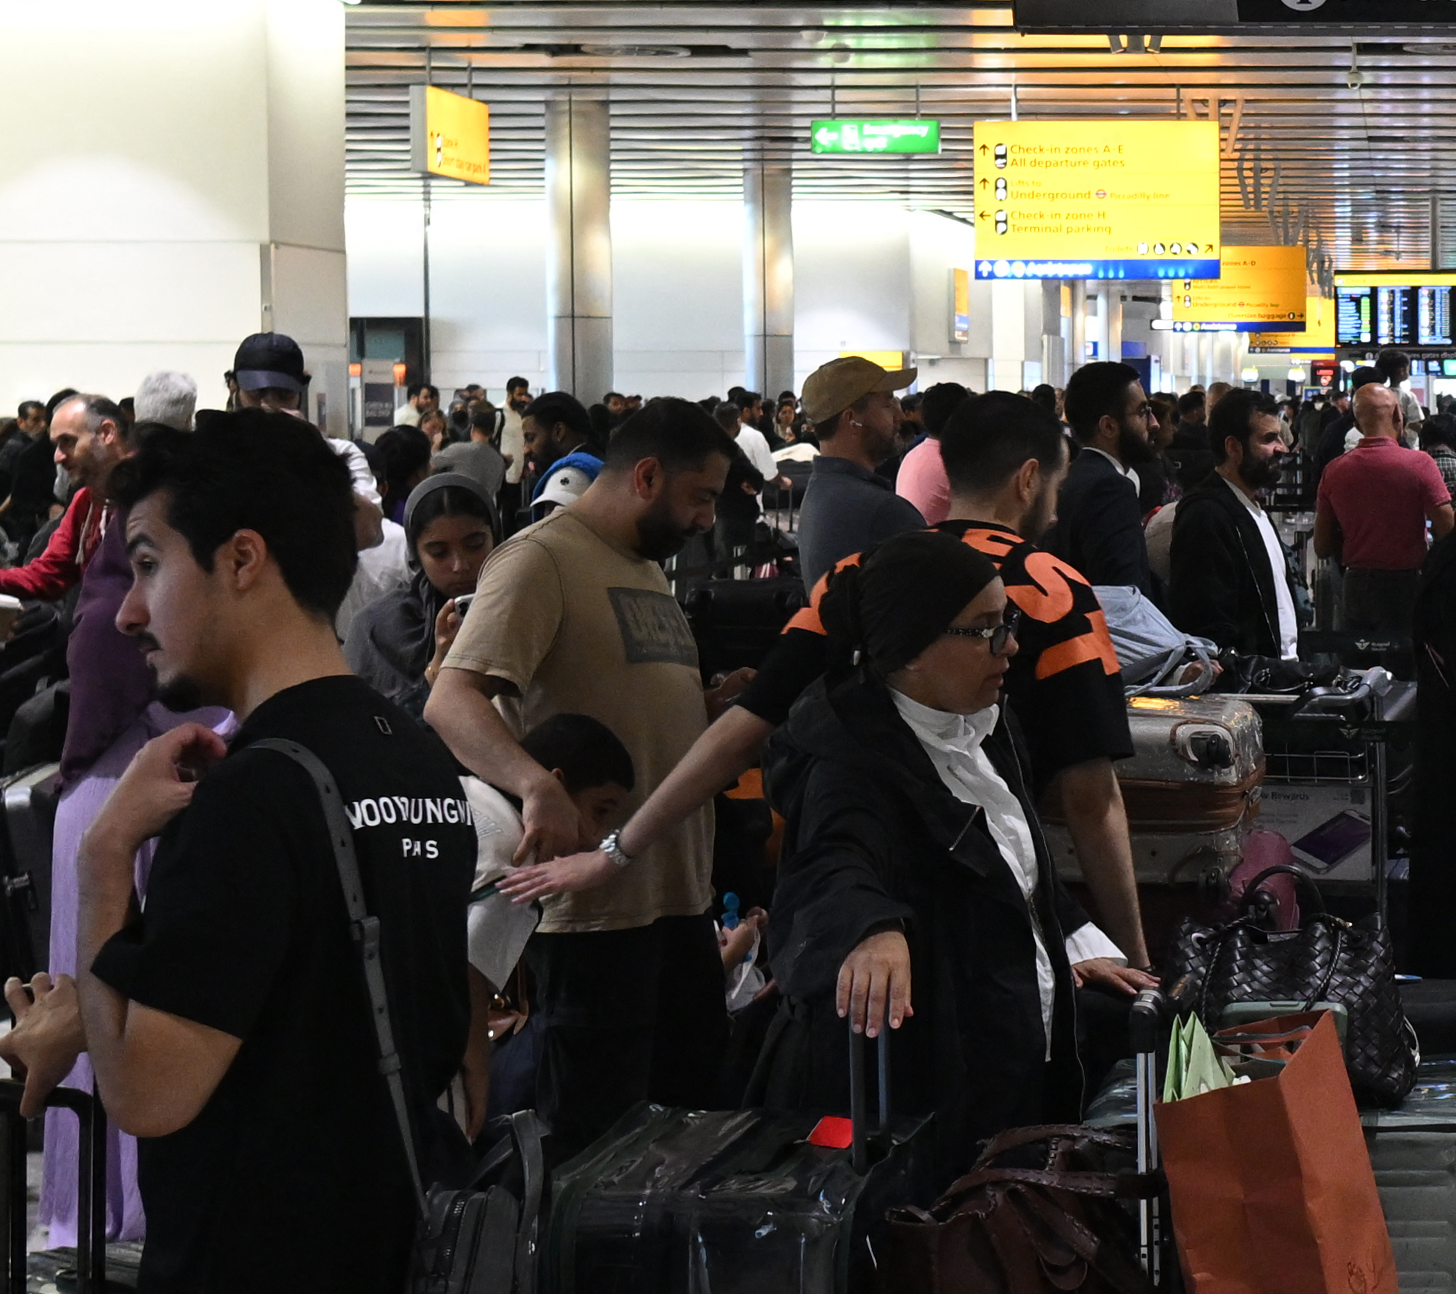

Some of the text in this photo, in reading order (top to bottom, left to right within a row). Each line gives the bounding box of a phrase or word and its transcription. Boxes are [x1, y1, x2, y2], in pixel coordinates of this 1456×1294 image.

[1009, 143, 1062, 155] Check-in
[1029, 158, 1089, 169] departure
[1010, 190, 1091, 202] Underground
[1109, 191, 1151, 202] Piccadilly
[1009, 209, 1062, 221] Check-in
[1011, 223, 1112, 235] Terminal parking
[1420, 350, 1441, 361] gates
